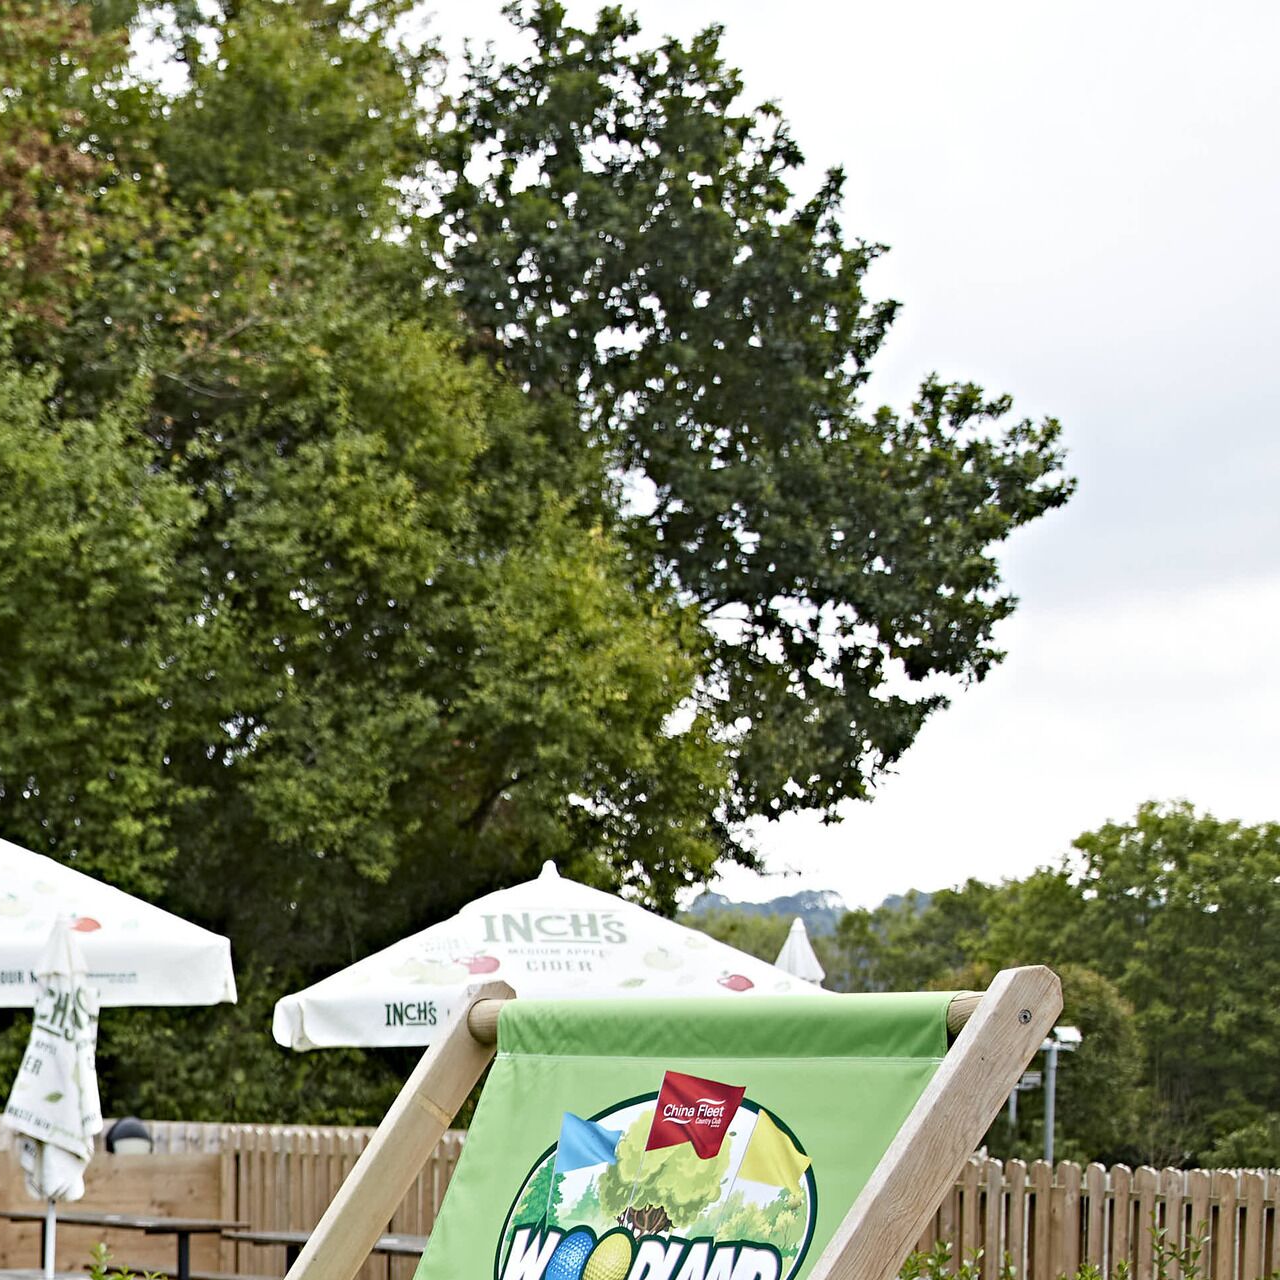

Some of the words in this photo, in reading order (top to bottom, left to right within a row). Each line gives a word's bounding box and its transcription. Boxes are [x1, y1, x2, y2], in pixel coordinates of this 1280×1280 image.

[480, 912, 628, 944] INCH'S
[526, 960, 593, 973] CIDER
[385, 1000, 438, 1027] INCH'S
[663, 1103, 695, 1117] China
[696, 1103, 726, 1118] Fleet
